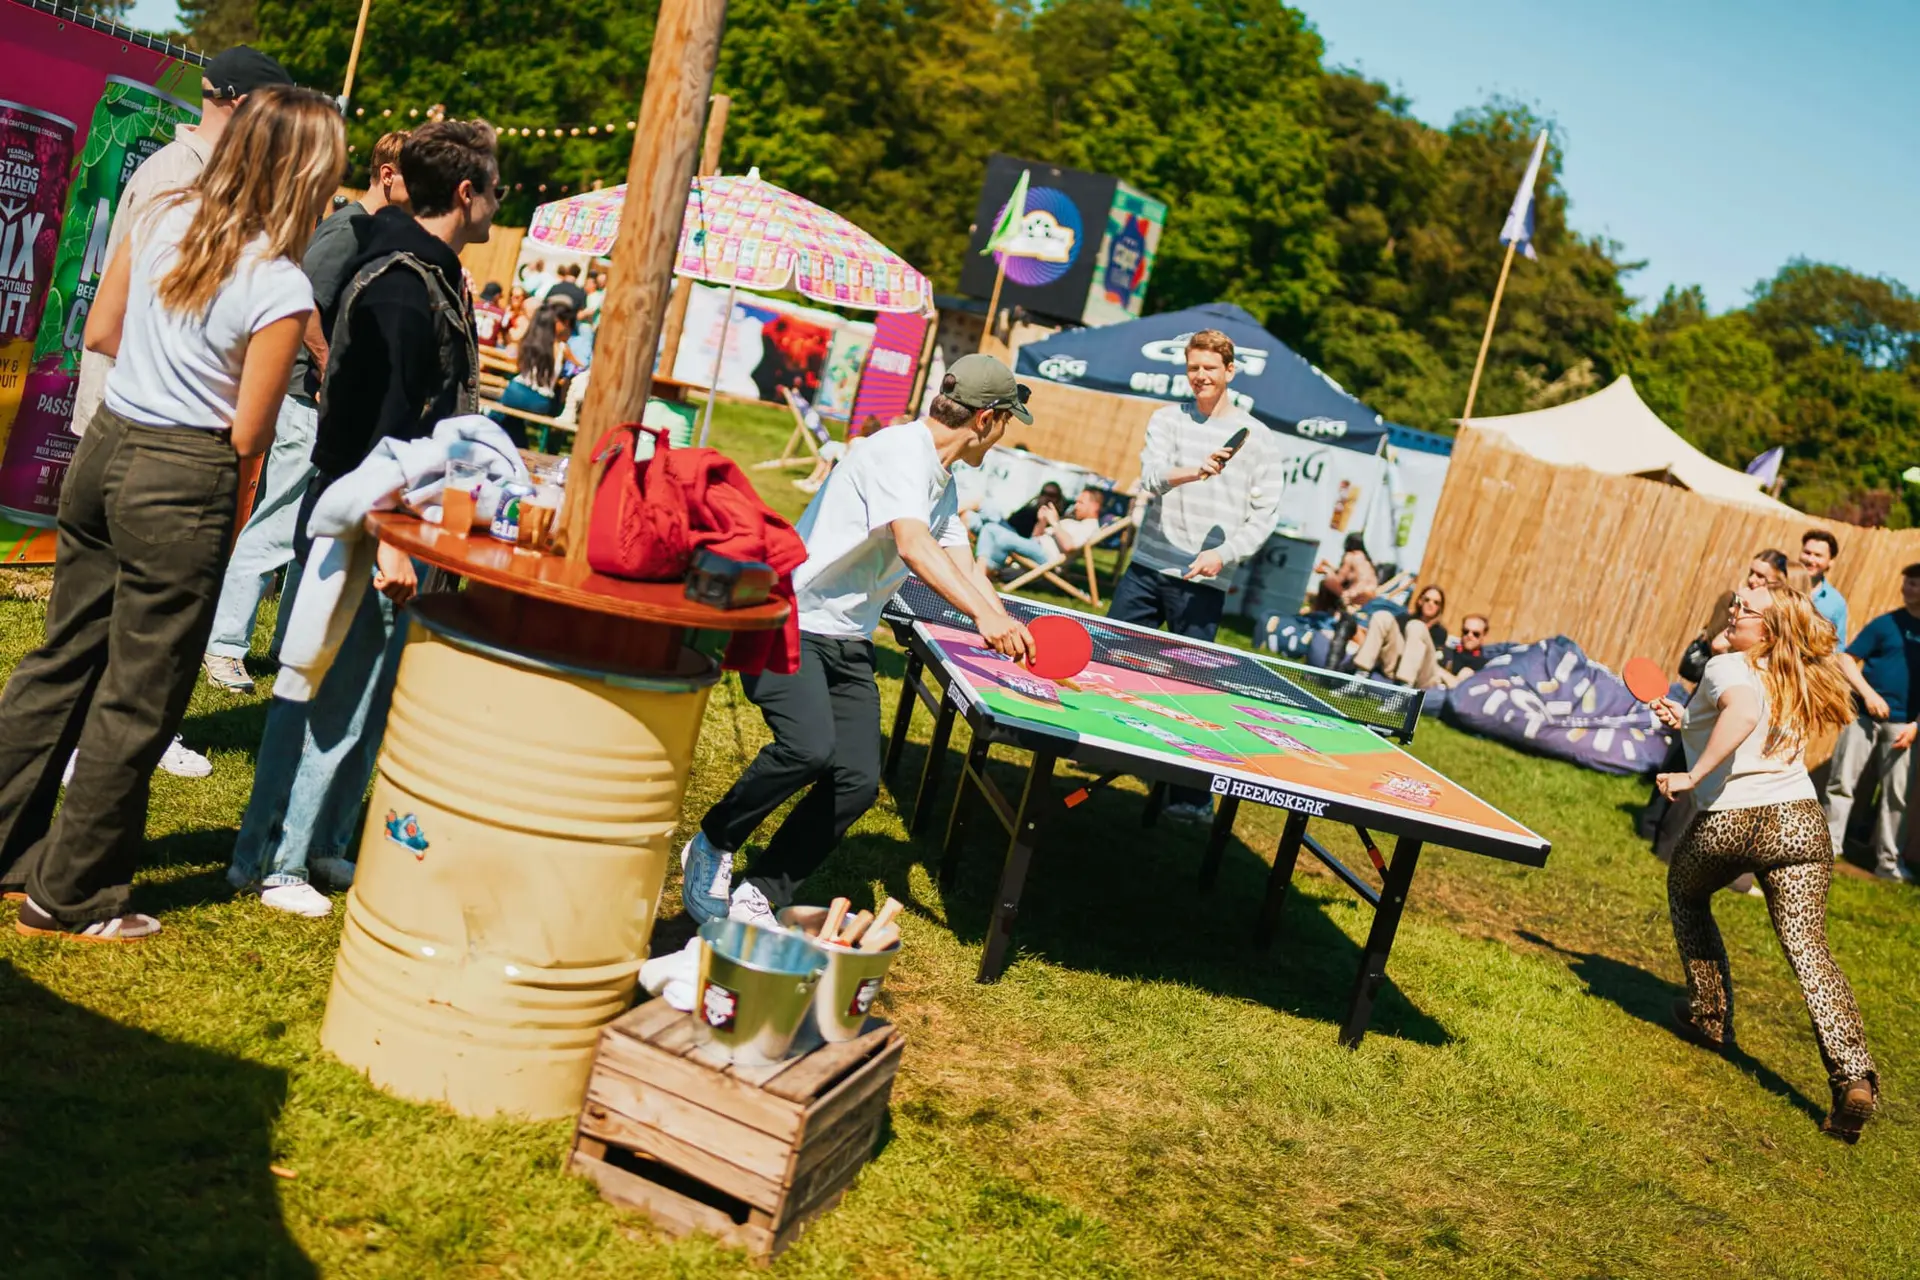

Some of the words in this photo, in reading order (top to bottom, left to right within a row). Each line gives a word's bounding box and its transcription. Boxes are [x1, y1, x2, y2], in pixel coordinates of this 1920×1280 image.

[8, 119, 29, 131] CRAFTED
[7, 147, 35, 160] FEARLESS
[0, 211, 45, 281] IX
[0, 374, 18, 389] UIT
[36, 446, 50, 455] BEER
[40, 465, 50, 478] NO
[1229, 781, 1328, 817] HEEMSKERK
